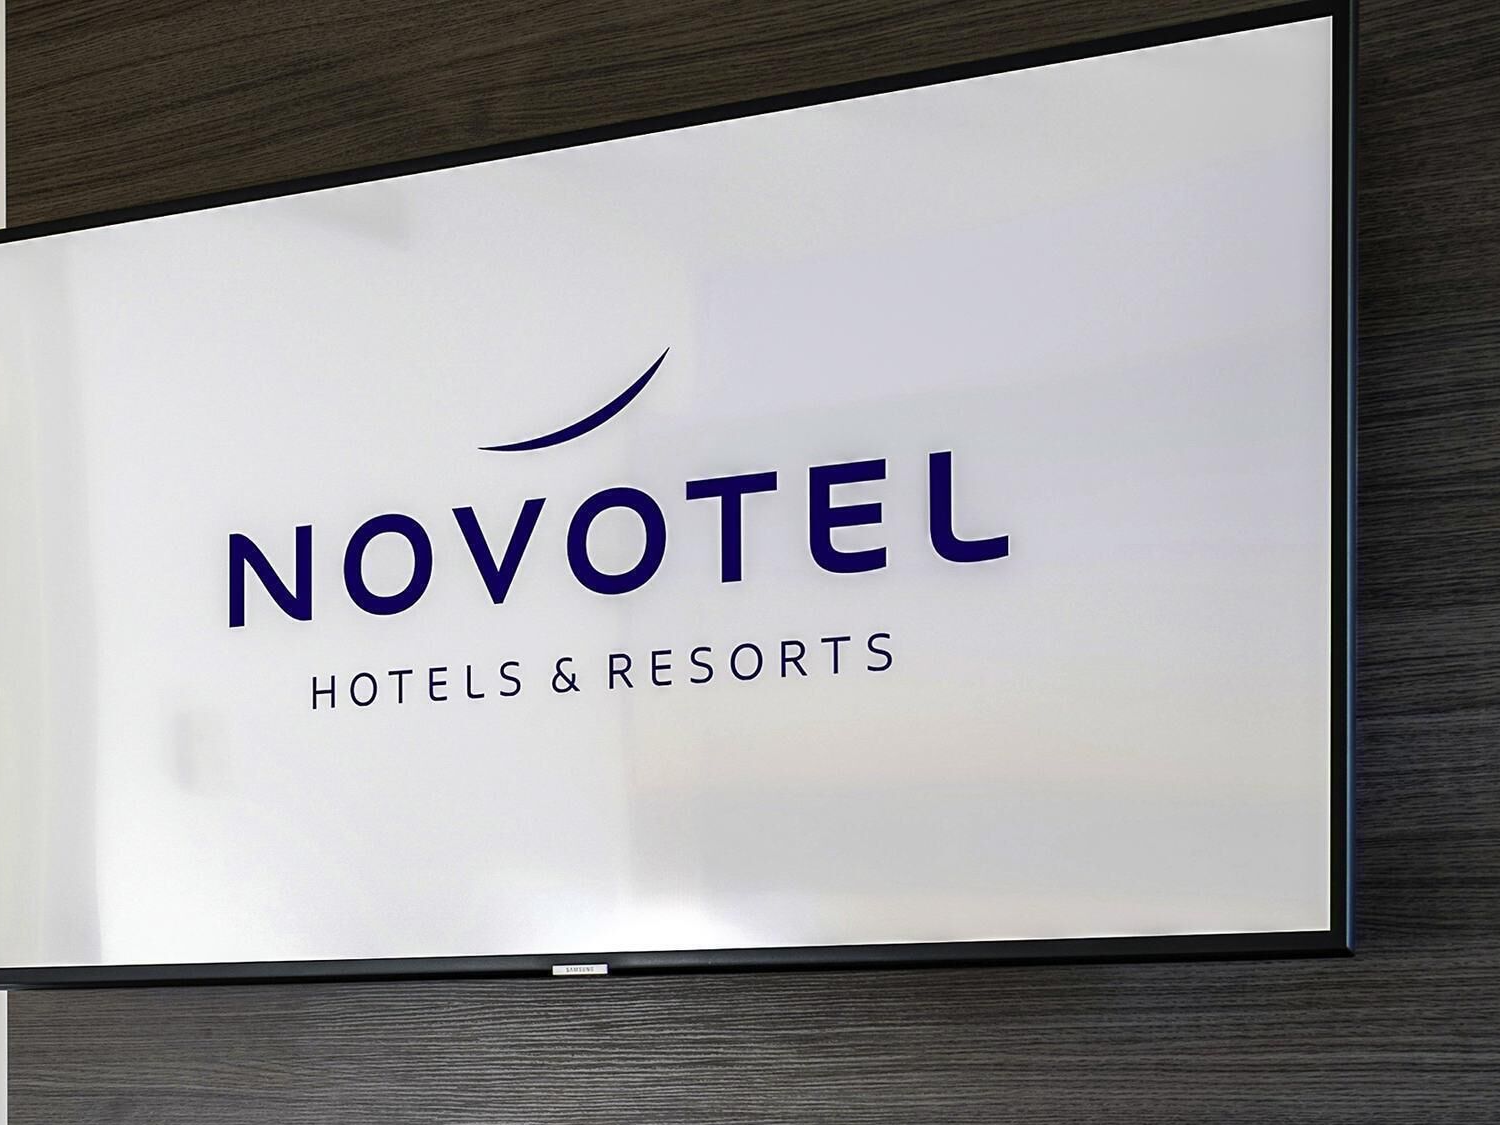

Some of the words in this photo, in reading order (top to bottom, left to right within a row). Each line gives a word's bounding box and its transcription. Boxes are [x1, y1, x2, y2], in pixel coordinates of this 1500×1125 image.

[229, 450, 1010, 628] NOVOTEL
[312, 660, 522, 710] HOTELS
[551, 656, 581, 694] &
[608, 632, 894, 690] RESORTS
